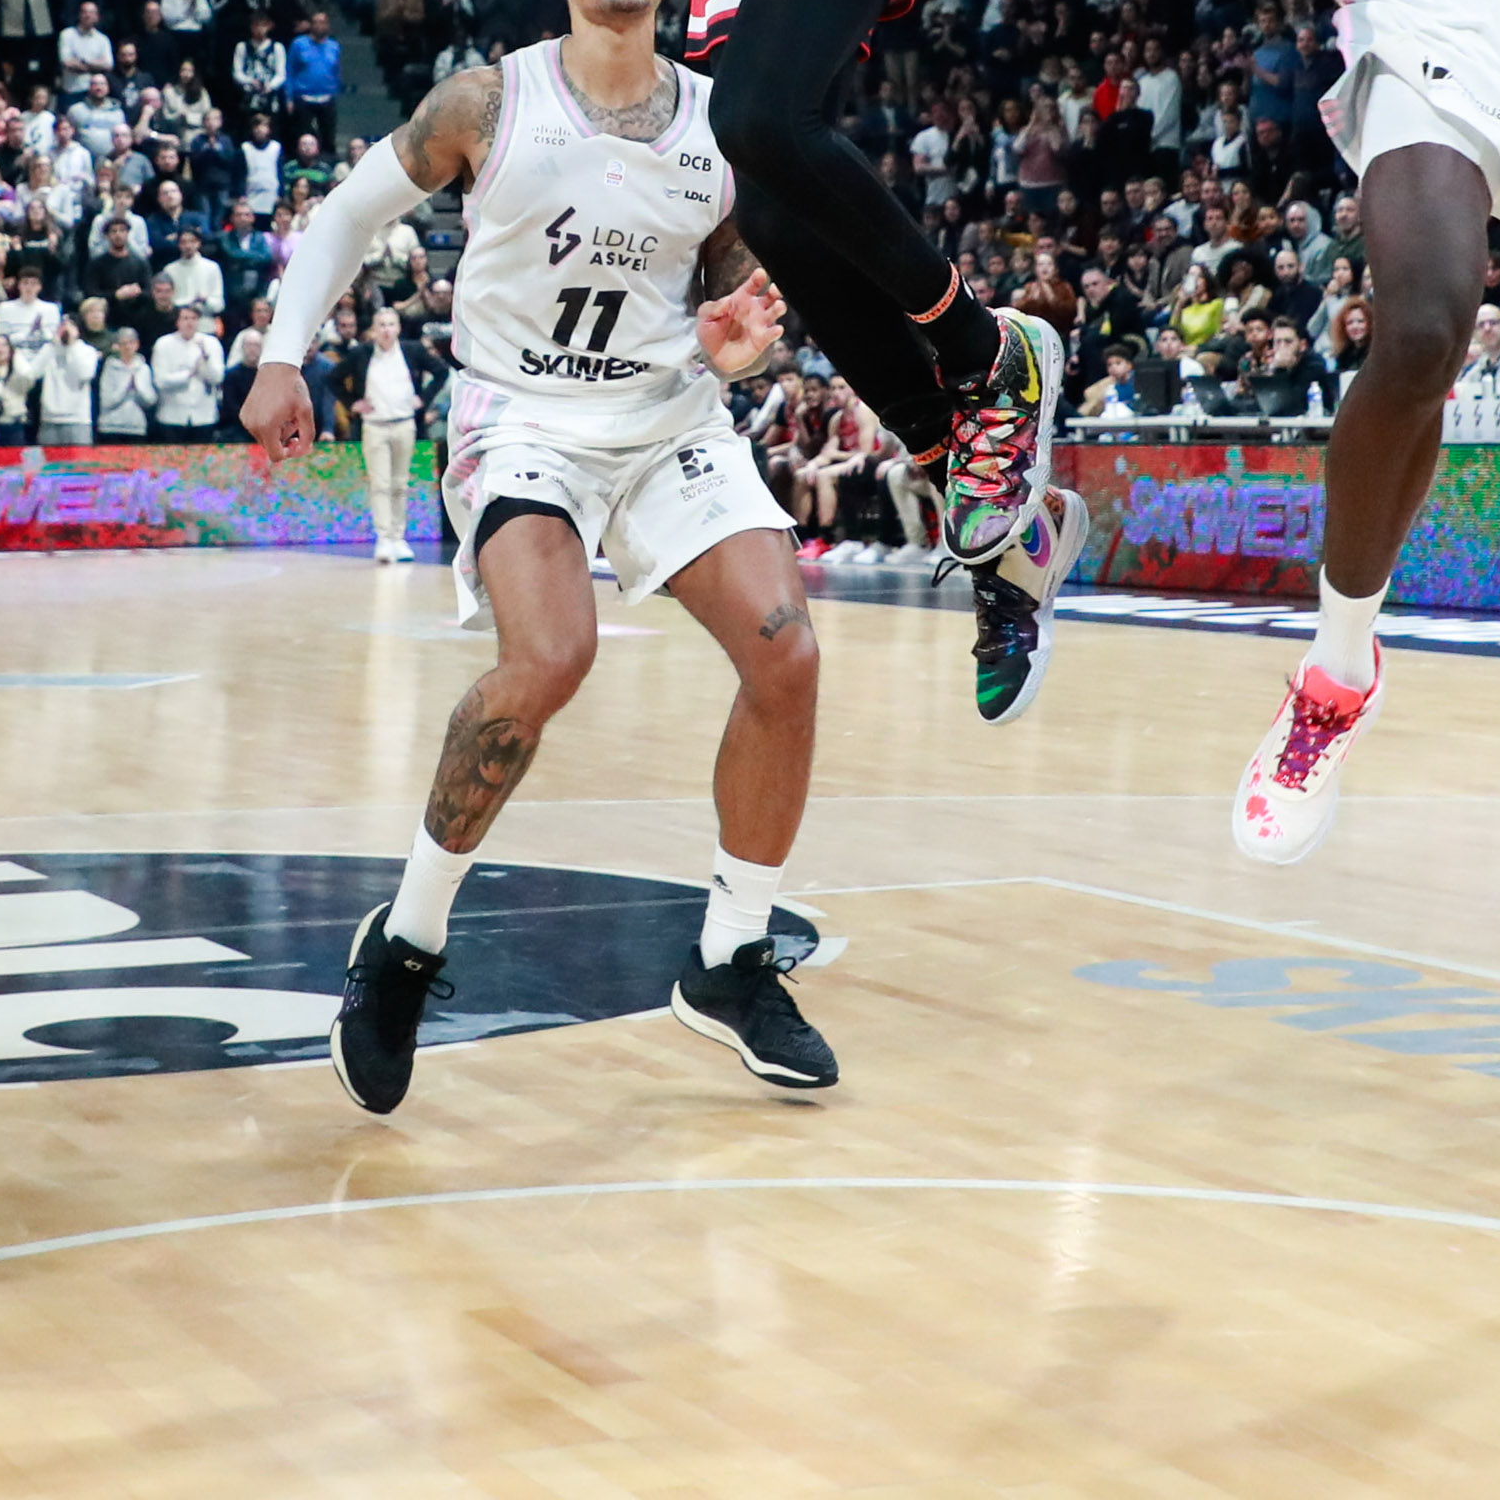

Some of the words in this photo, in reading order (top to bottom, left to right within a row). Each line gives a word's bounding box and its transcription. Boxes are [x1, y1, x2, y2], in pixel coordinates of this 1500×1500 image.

[533, 135, 566, 146] CISCO
[679, 152, 713, 174] DCB
[684, 190, 712, 204] LDLC
[591, 226, 660, 255] LDLC
[551, 285, 629, 353] 11
